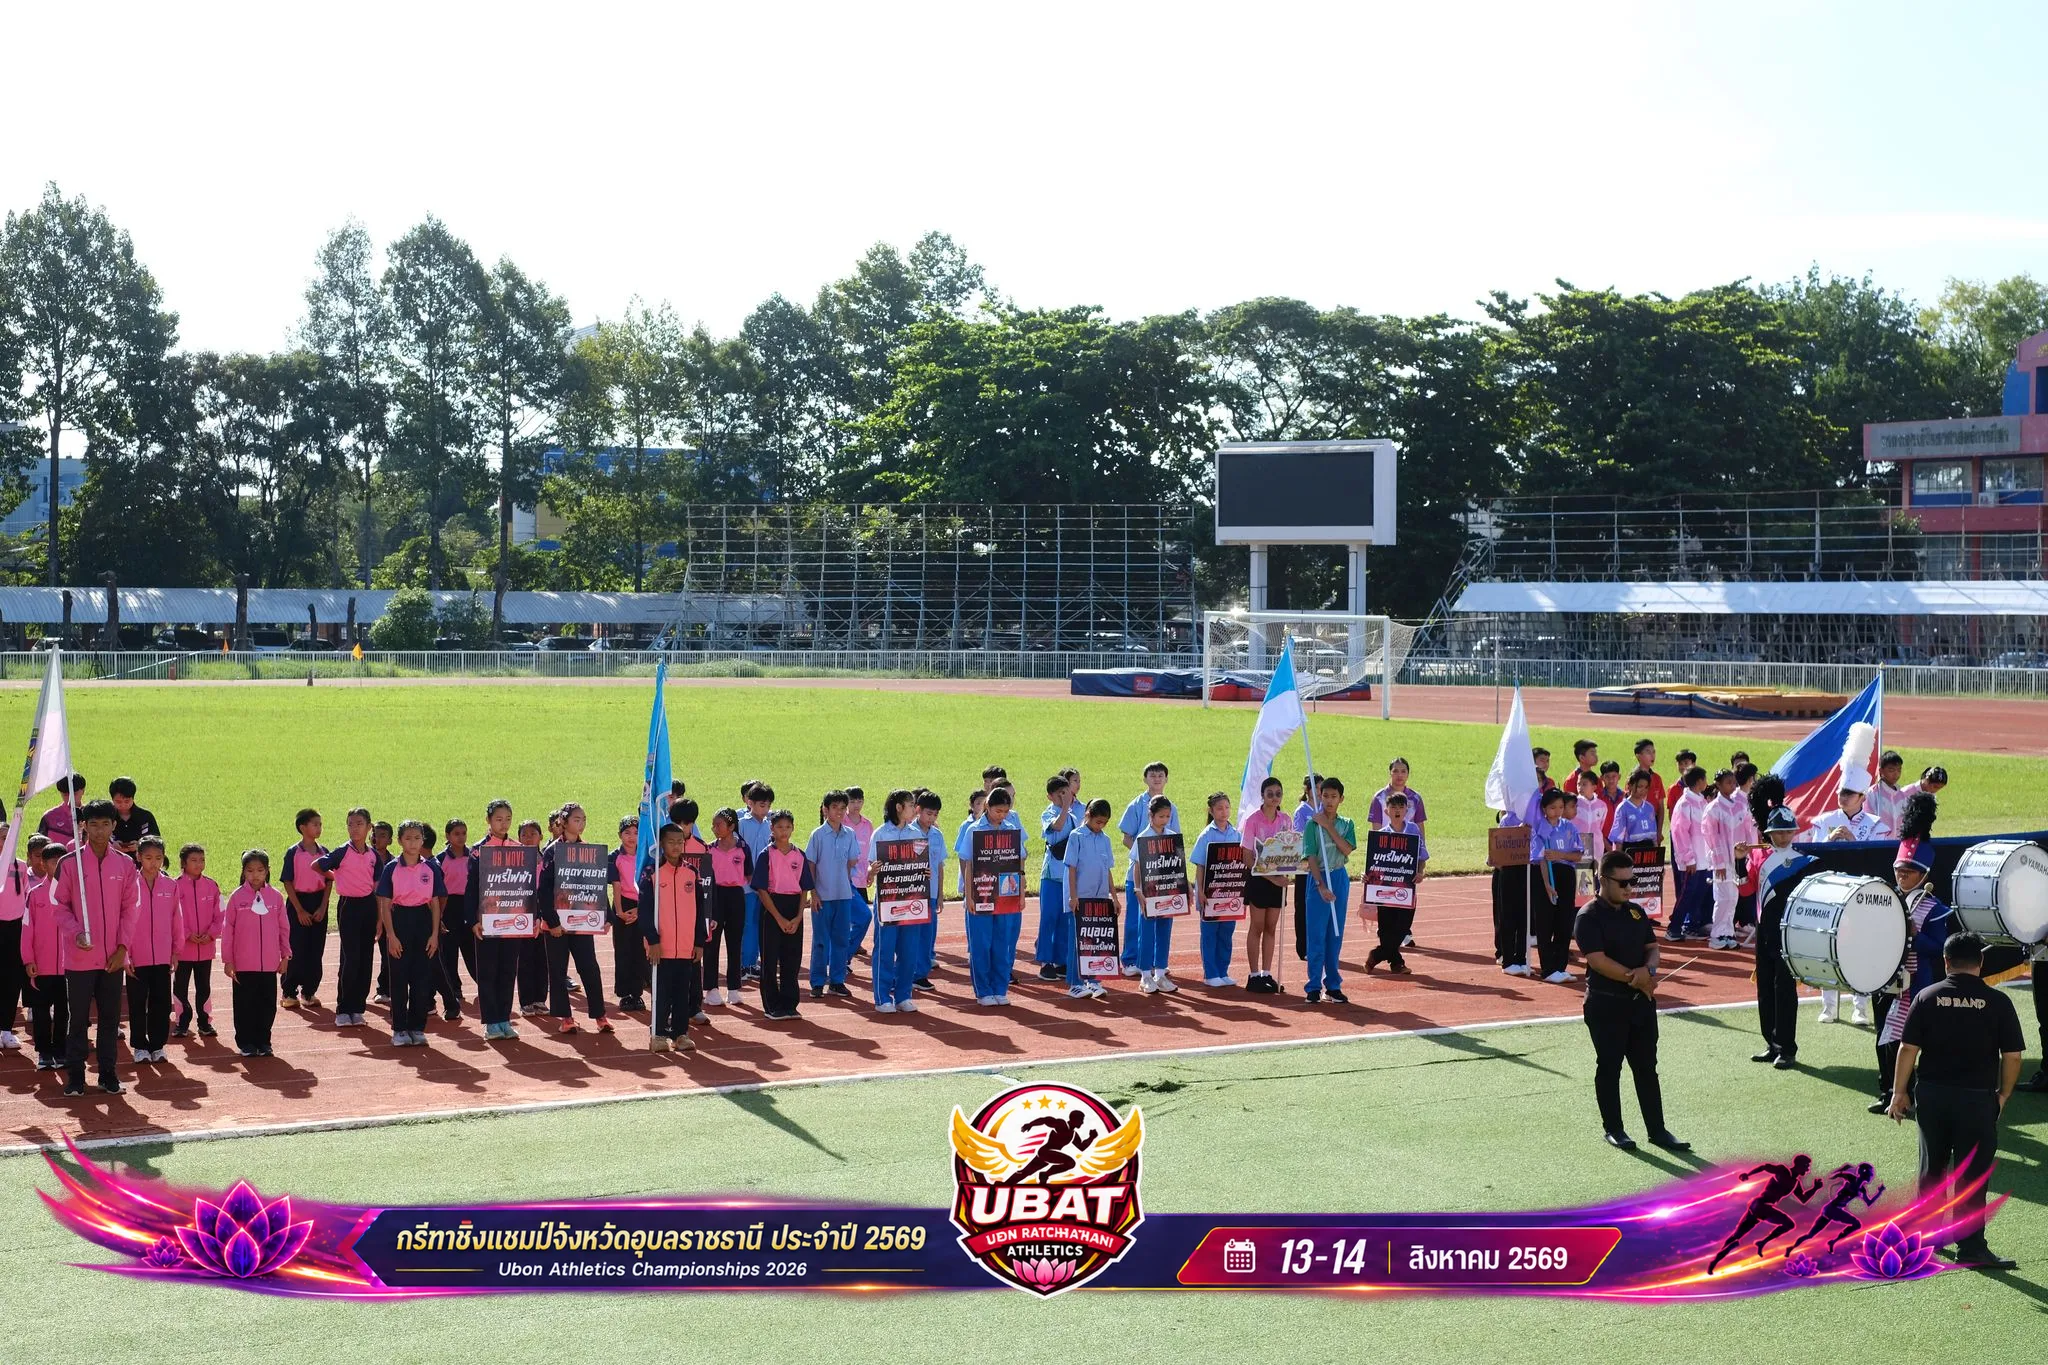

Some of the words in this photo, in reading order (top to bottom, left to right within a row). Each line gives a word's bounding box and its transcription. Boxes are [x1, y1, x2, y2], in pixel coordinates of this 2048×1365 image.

[1641, 820, 1648, 829] 13
[888, 844, 898, 859] UB
[900, 843, 918, 859] MOV
[1556, 840, 1564, 849] 10
[1373, 850, 1414, 864] บุหรี่ไฟฟ้า
[1146, 855, 1182, 874] บุหรี่ไฟฟ้า
[2028, 858, 2048, 876] YAMAH
[487, 868, 532, 888] บุหรี่ไฟฟ้า
[558, 867, 607, 880] หยุดขายชาติ
[1865, 893, 1892, 907] YAMAHA
[1804, 907, 1830, 919] YAMAHA
[1080, 926, 1115, 943] คนอุบล
[1953, 997, 1986, 1009] BAND
